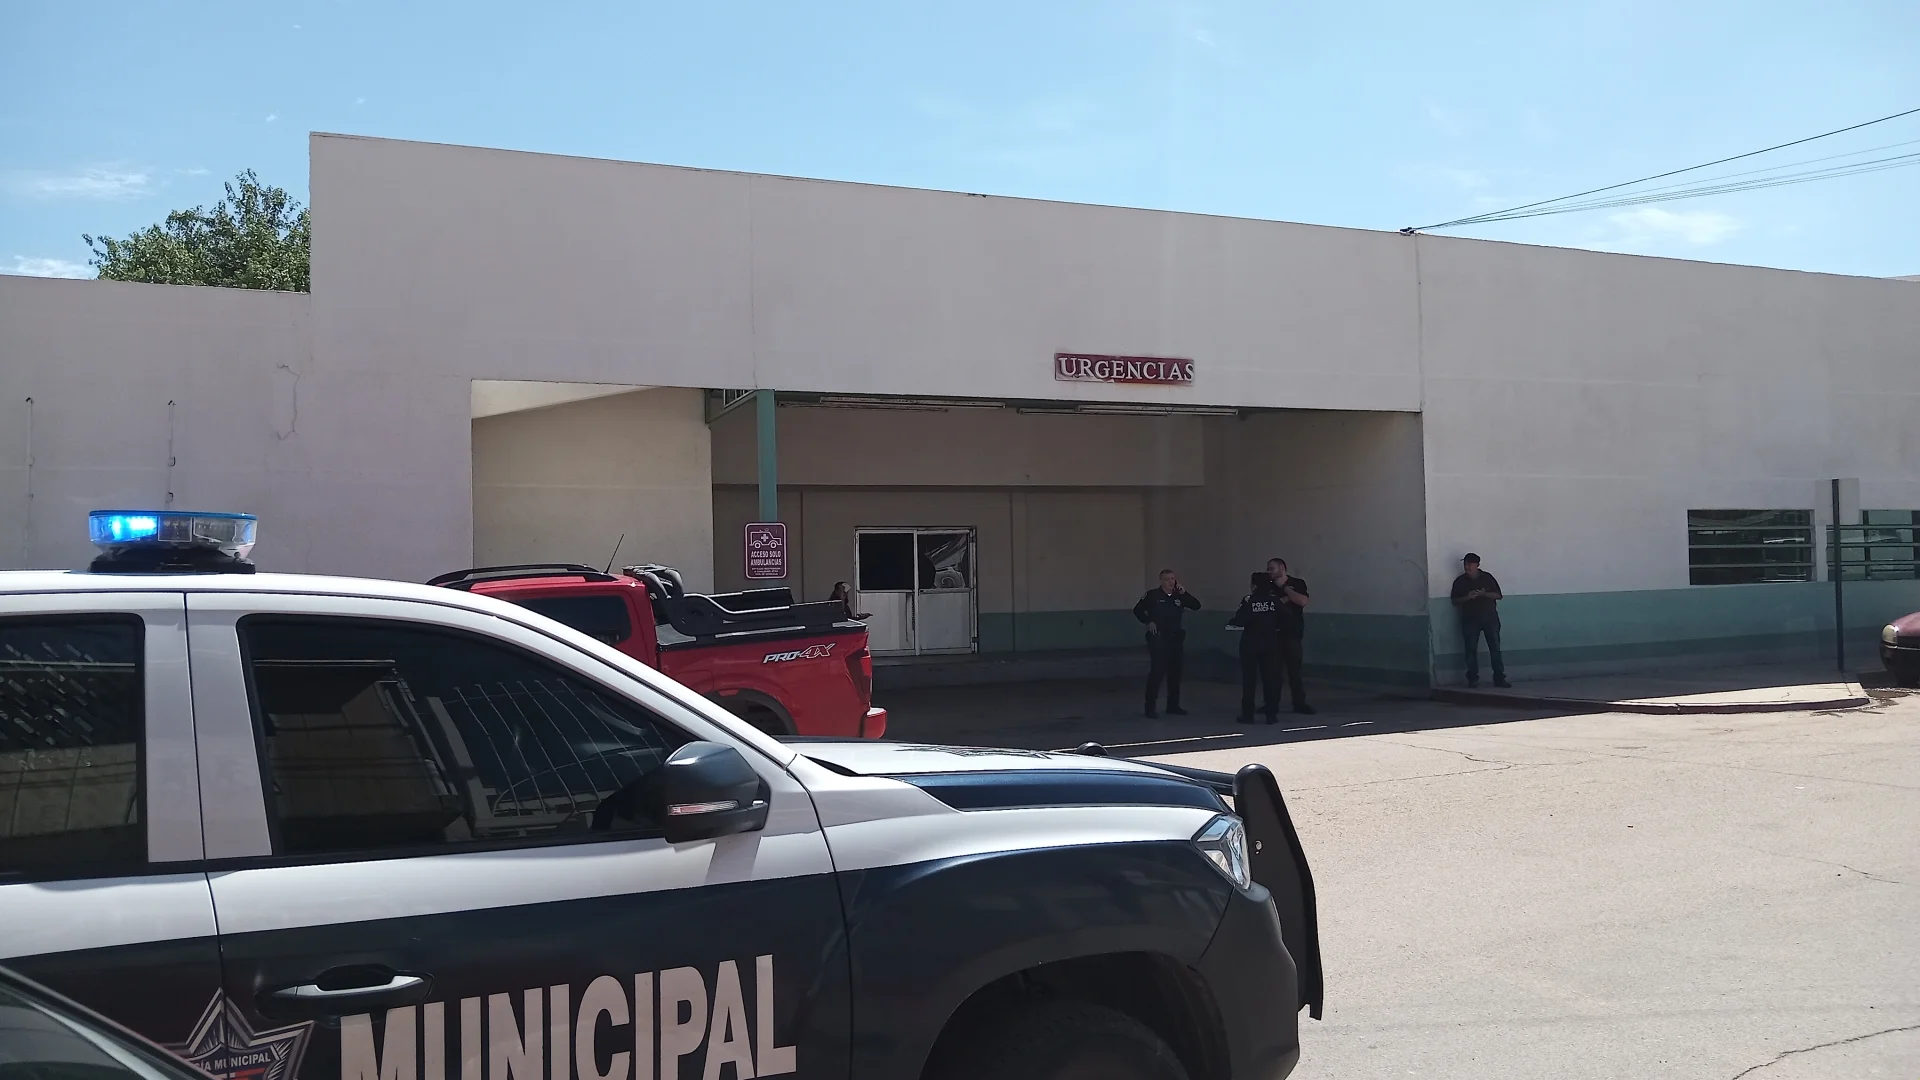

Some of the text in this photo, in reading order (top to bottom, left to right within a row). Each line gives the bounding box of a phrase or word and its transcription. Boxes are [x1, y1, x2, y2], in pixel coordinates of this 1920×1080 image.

[1058, 357, 1194, 381] URGENCIAS
[751, 550, 782, 558] ACCESO SOLO
[340, 954, 797, 1080] MUNICIPAL
